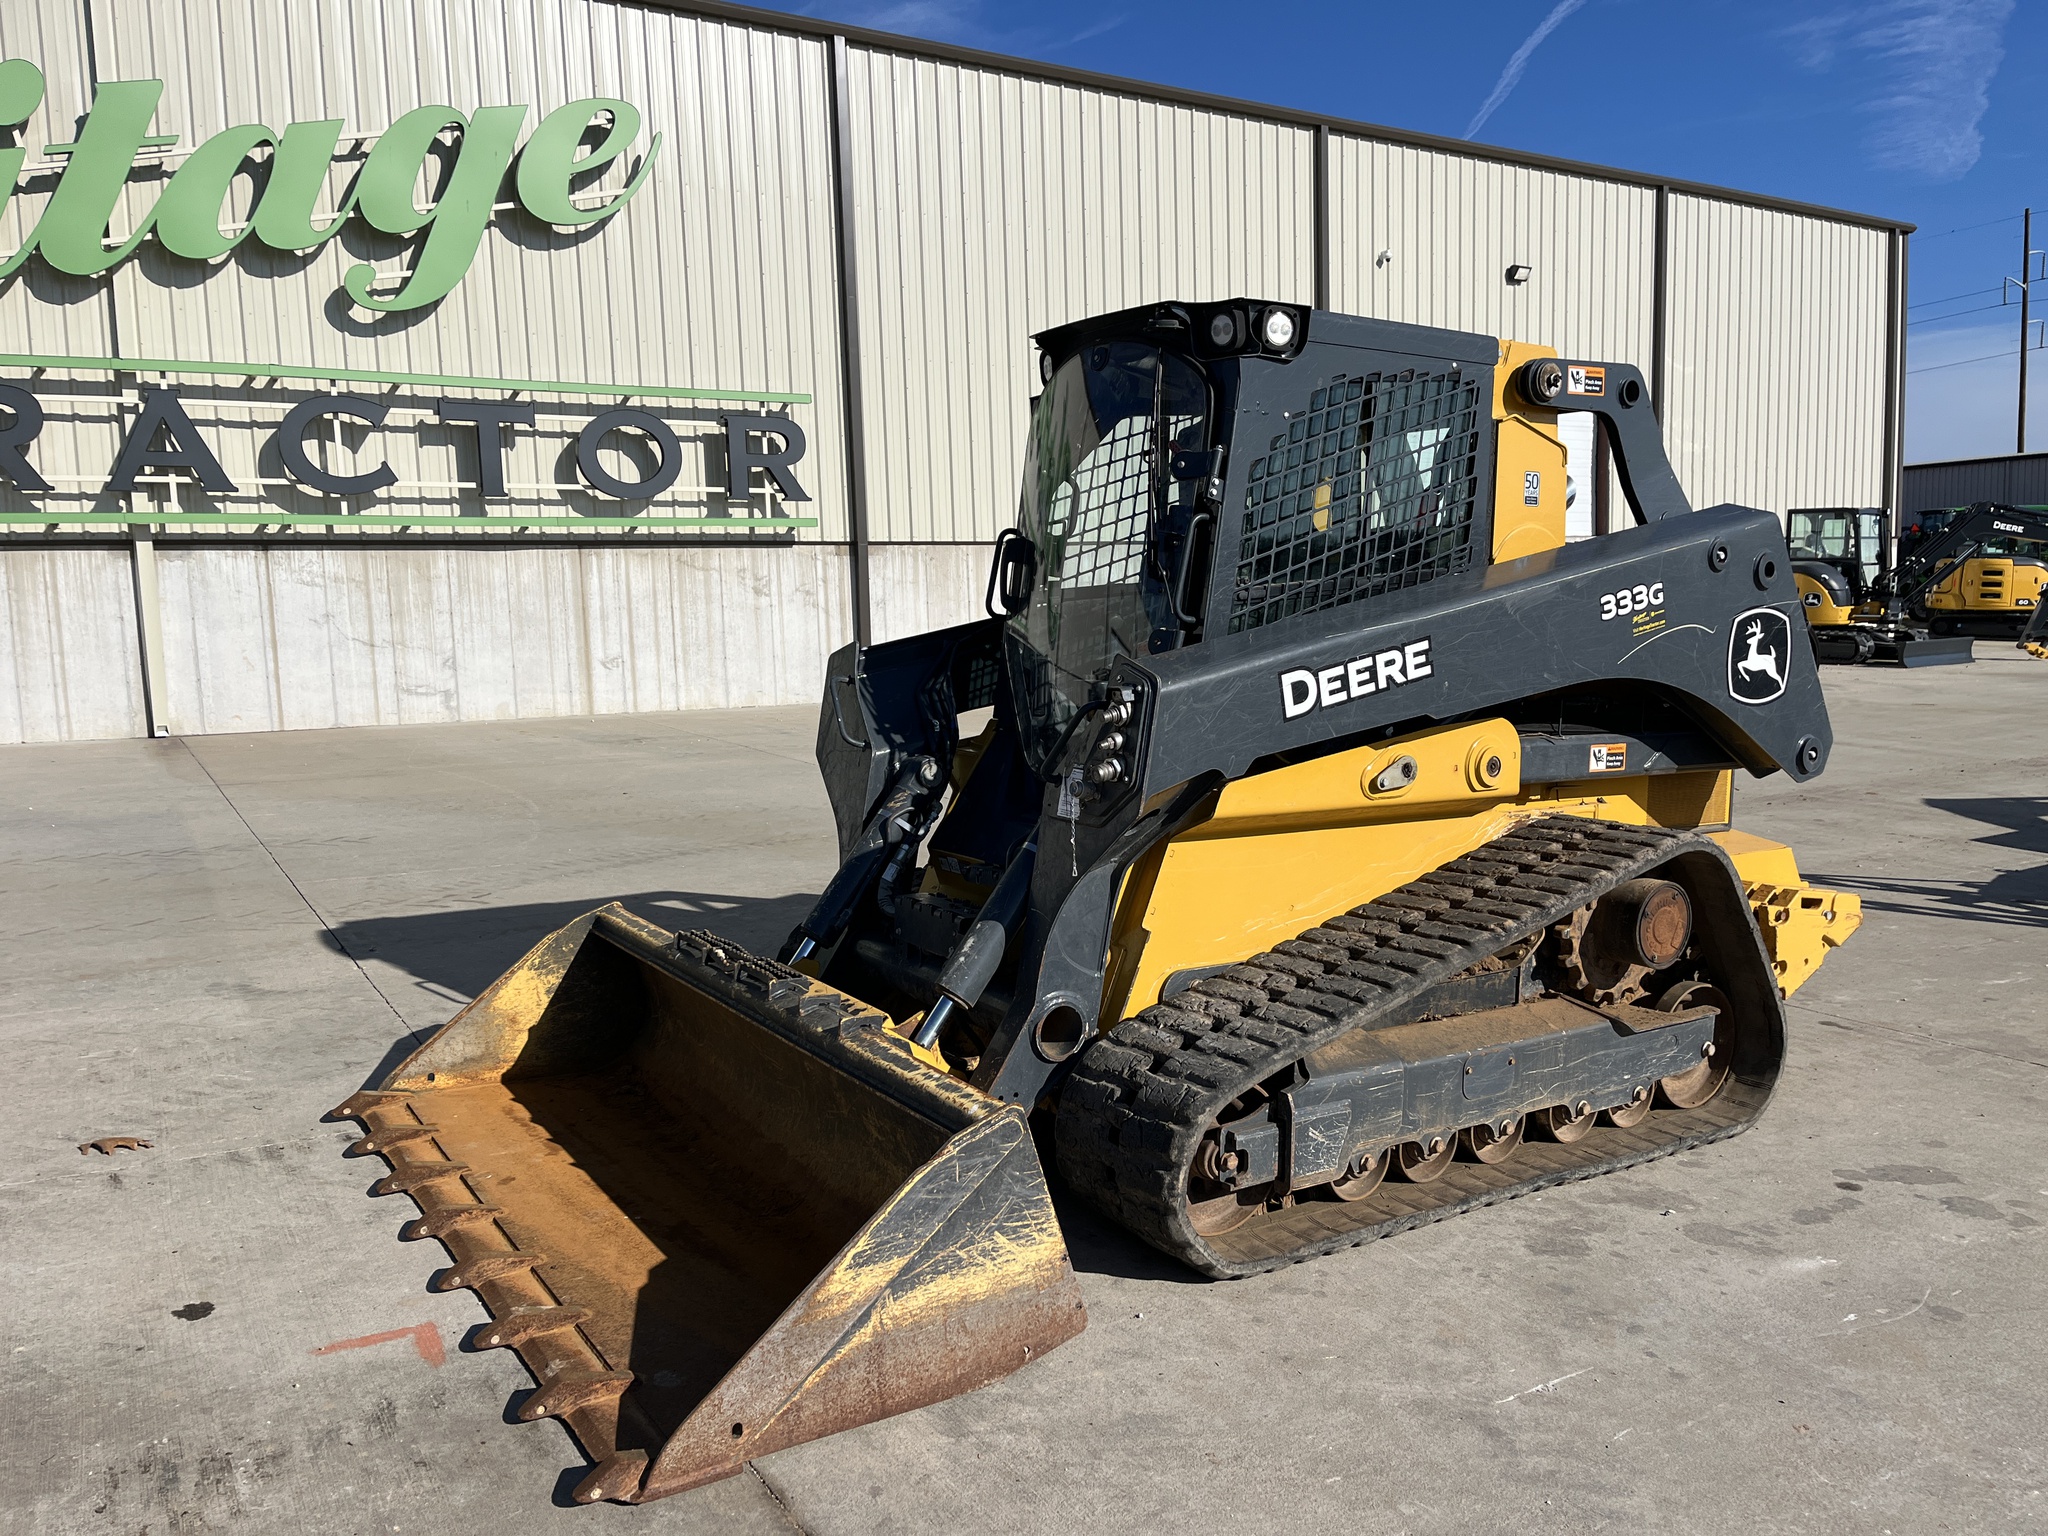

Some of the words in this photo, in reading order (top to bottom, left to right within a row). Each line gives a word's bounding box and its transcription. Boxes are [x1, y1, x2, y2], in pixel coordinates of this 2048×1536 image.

[1525, 473, 1539, 490] 50
[1993, 520, 2025, 534] DEERE
[1600, 581, 1665, 620] 333G
[1280, 638, 1433, 720] DEERE
